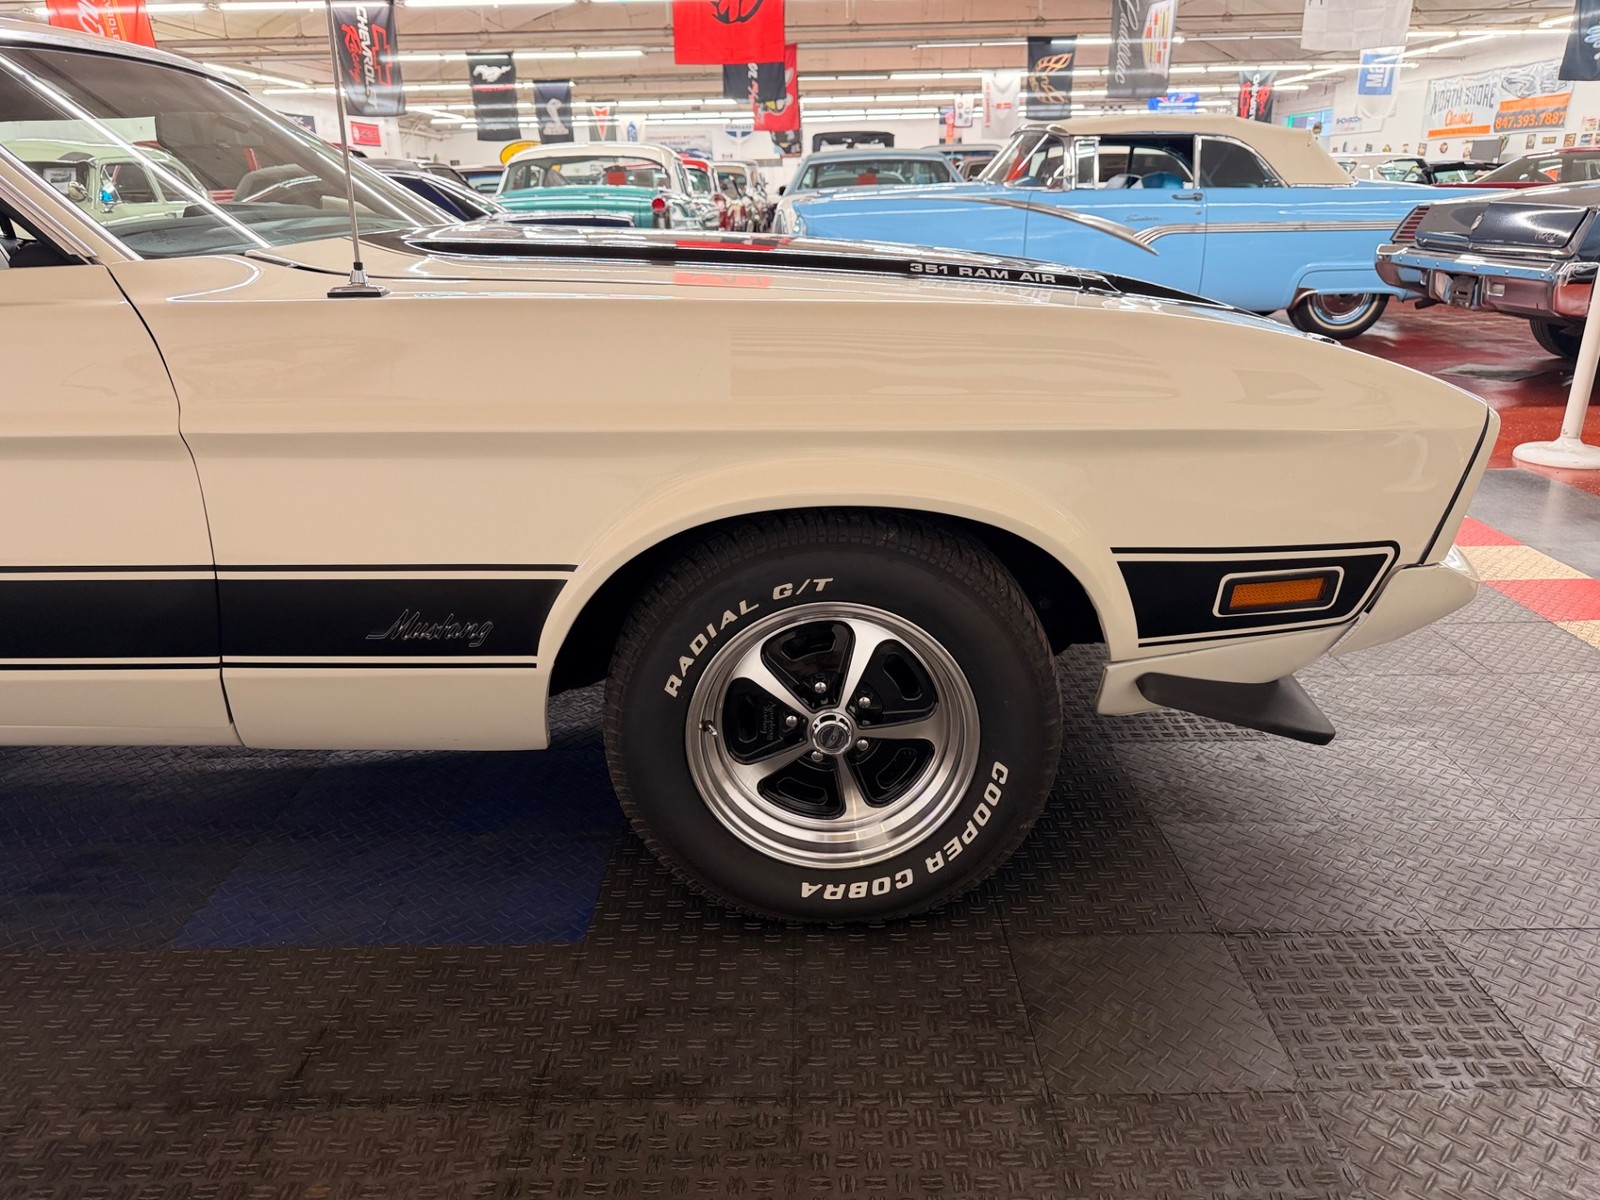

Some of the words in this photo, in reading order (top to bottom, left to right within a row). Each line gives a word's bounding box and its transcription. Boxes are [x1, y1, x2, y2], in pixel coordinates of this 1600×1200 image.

[355, 5, 378, 110] CHEVROLET
[1430, 86, 1463, 116] NORTH
[1464, 82, 1497, 109] SHORE
[1495, 111, 1566, 129] 847.393.7887
[909, 262, 949, 274] 351
[958, 266, 1009, 280] RAM
[1019, 273, 1057, 284] AIR
[365, 608, 494, 648] Mustang
[664, 600, 760, 698] RADIAL
[772, 577, 834, 600] G/T
[924, 761, 1009, 874] COOPER
[801, 868, 914, 900] COBRA
